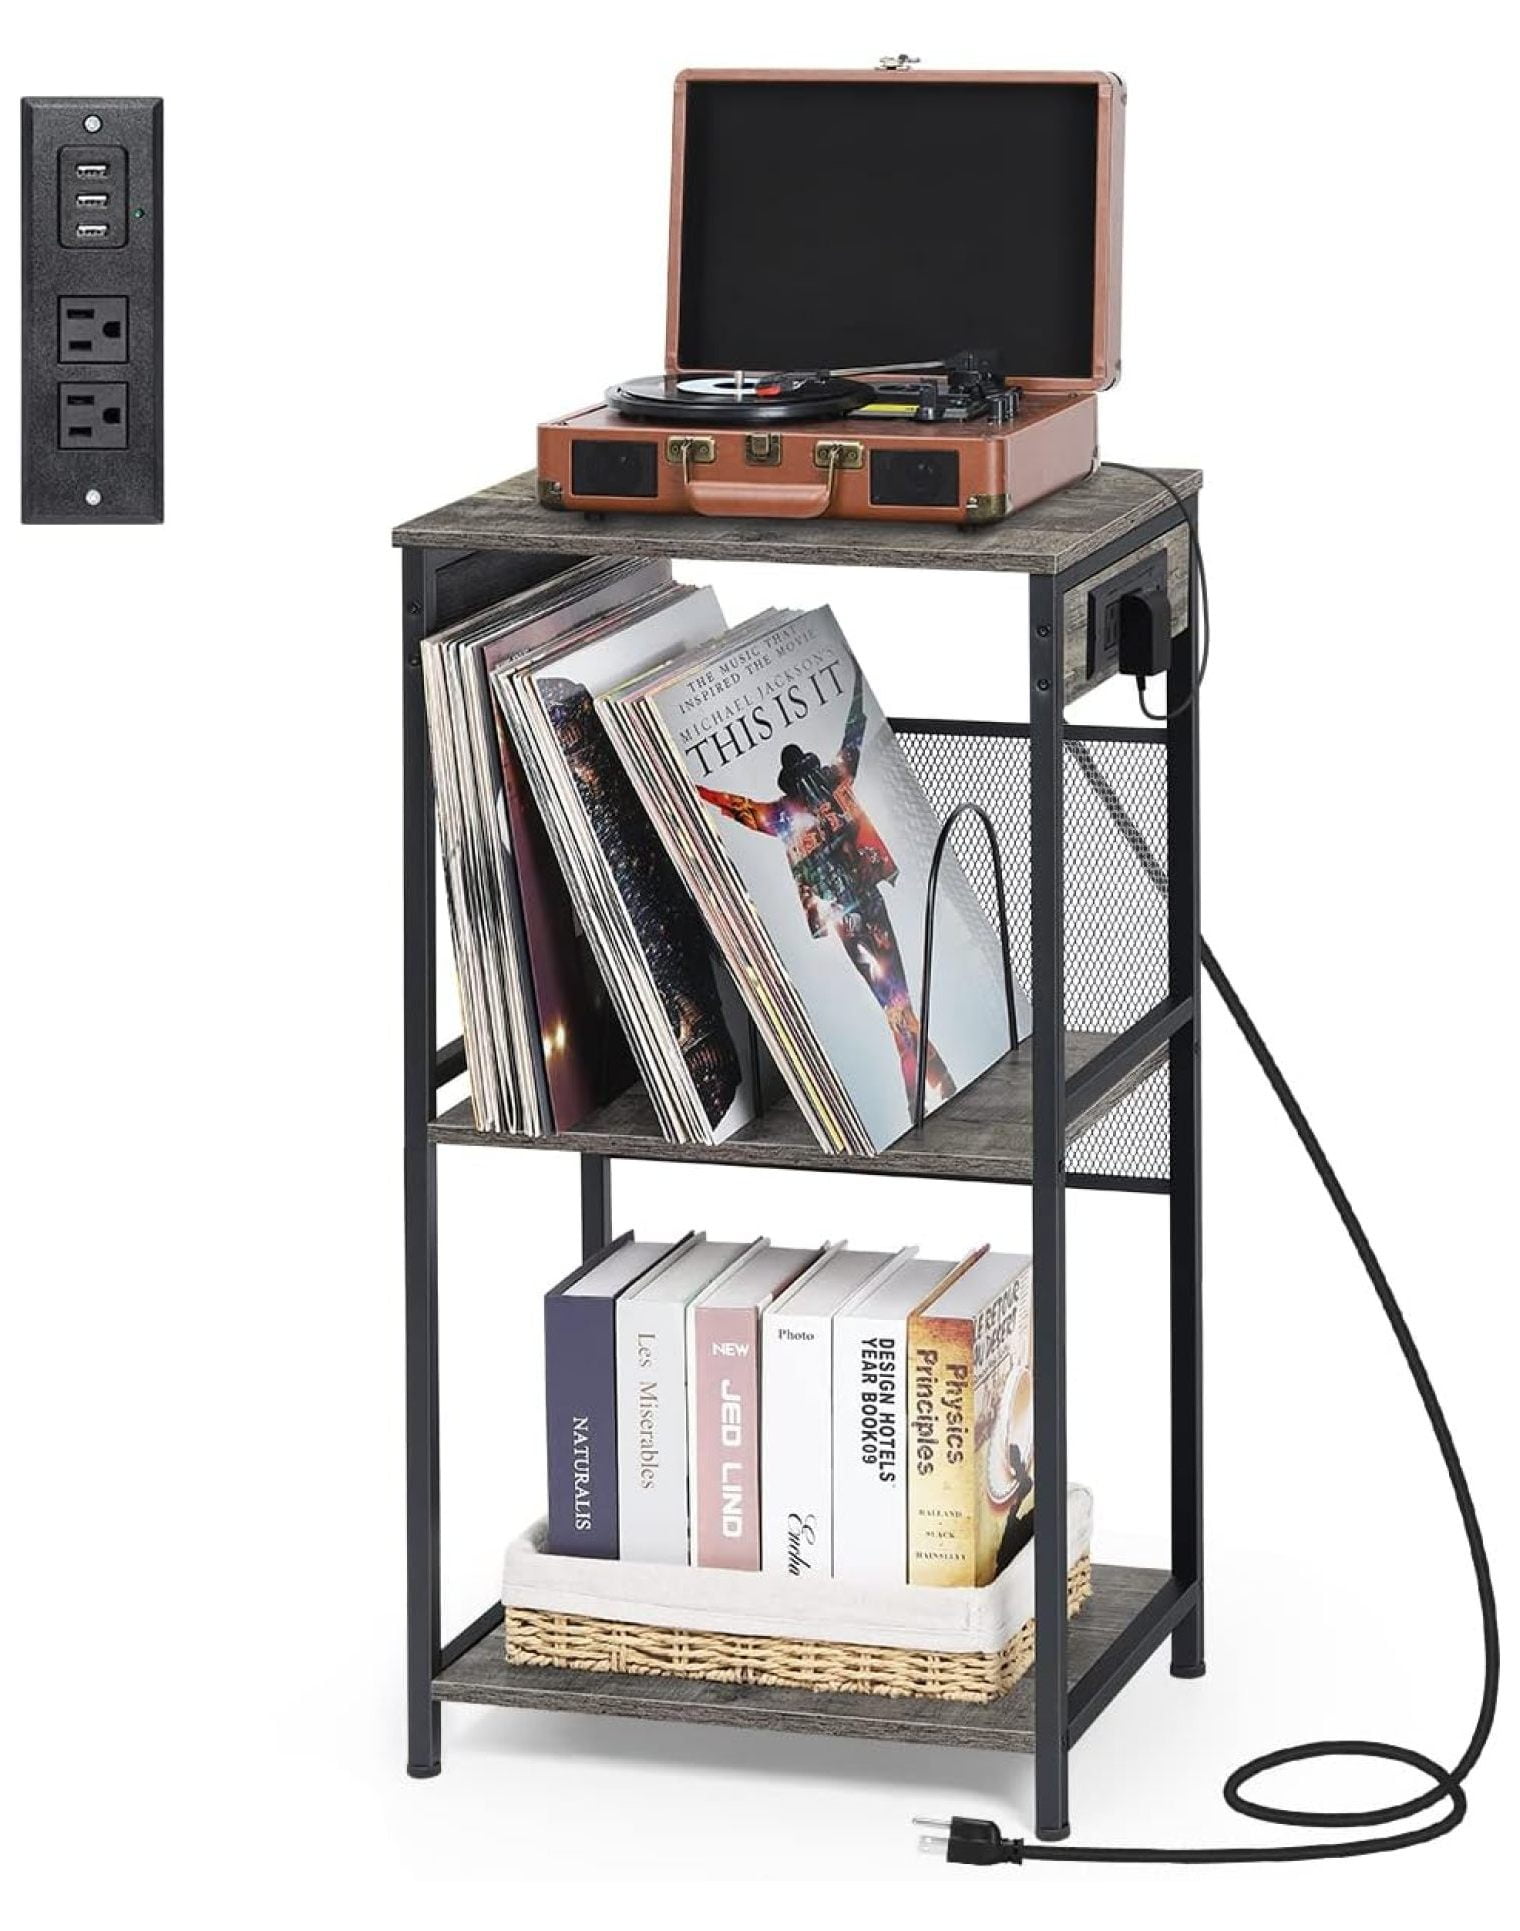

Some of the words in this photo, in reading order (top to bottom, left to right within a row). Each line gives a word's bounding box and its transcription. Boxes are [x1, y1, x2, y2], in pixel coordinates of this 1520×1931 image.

[679, 674, 742, 715] INSPIRED
[745, 656, 772, 675] THE
[777, 628, 815, 658] MOVIE
[687, 670, 715, 693] THE
[718, 648, 762, 676] MUSIC
[678, 694, 752, 745] MICHAEL
[685, 706, 774, 778] THIS
[774, 684, 810, 729] IS
[808, 660, 844, 707] IT
[638, 1332, 656, 1368] Les
[712, 1341, 751, 1357] NEW
[778, 1327, 816, 1341] Photo
[861, 1337, 878, 1385] YEAR
[878, 1338, 896, 1406] DESIGN
[639, 1381, 660, 1490] Miserables
[721, 1378, 744, 1448] JED
[861, 1390, 878, 1465] BOOK09
[879, 1411, 896, 1484] HOTELS
[915, 1349, 940, 1477] Principles
[945, 1363, 970, 1465] Physics
[573, 1416, 593, 1532] NATURALIS
[722, 1461, 745, 1539] LIND
